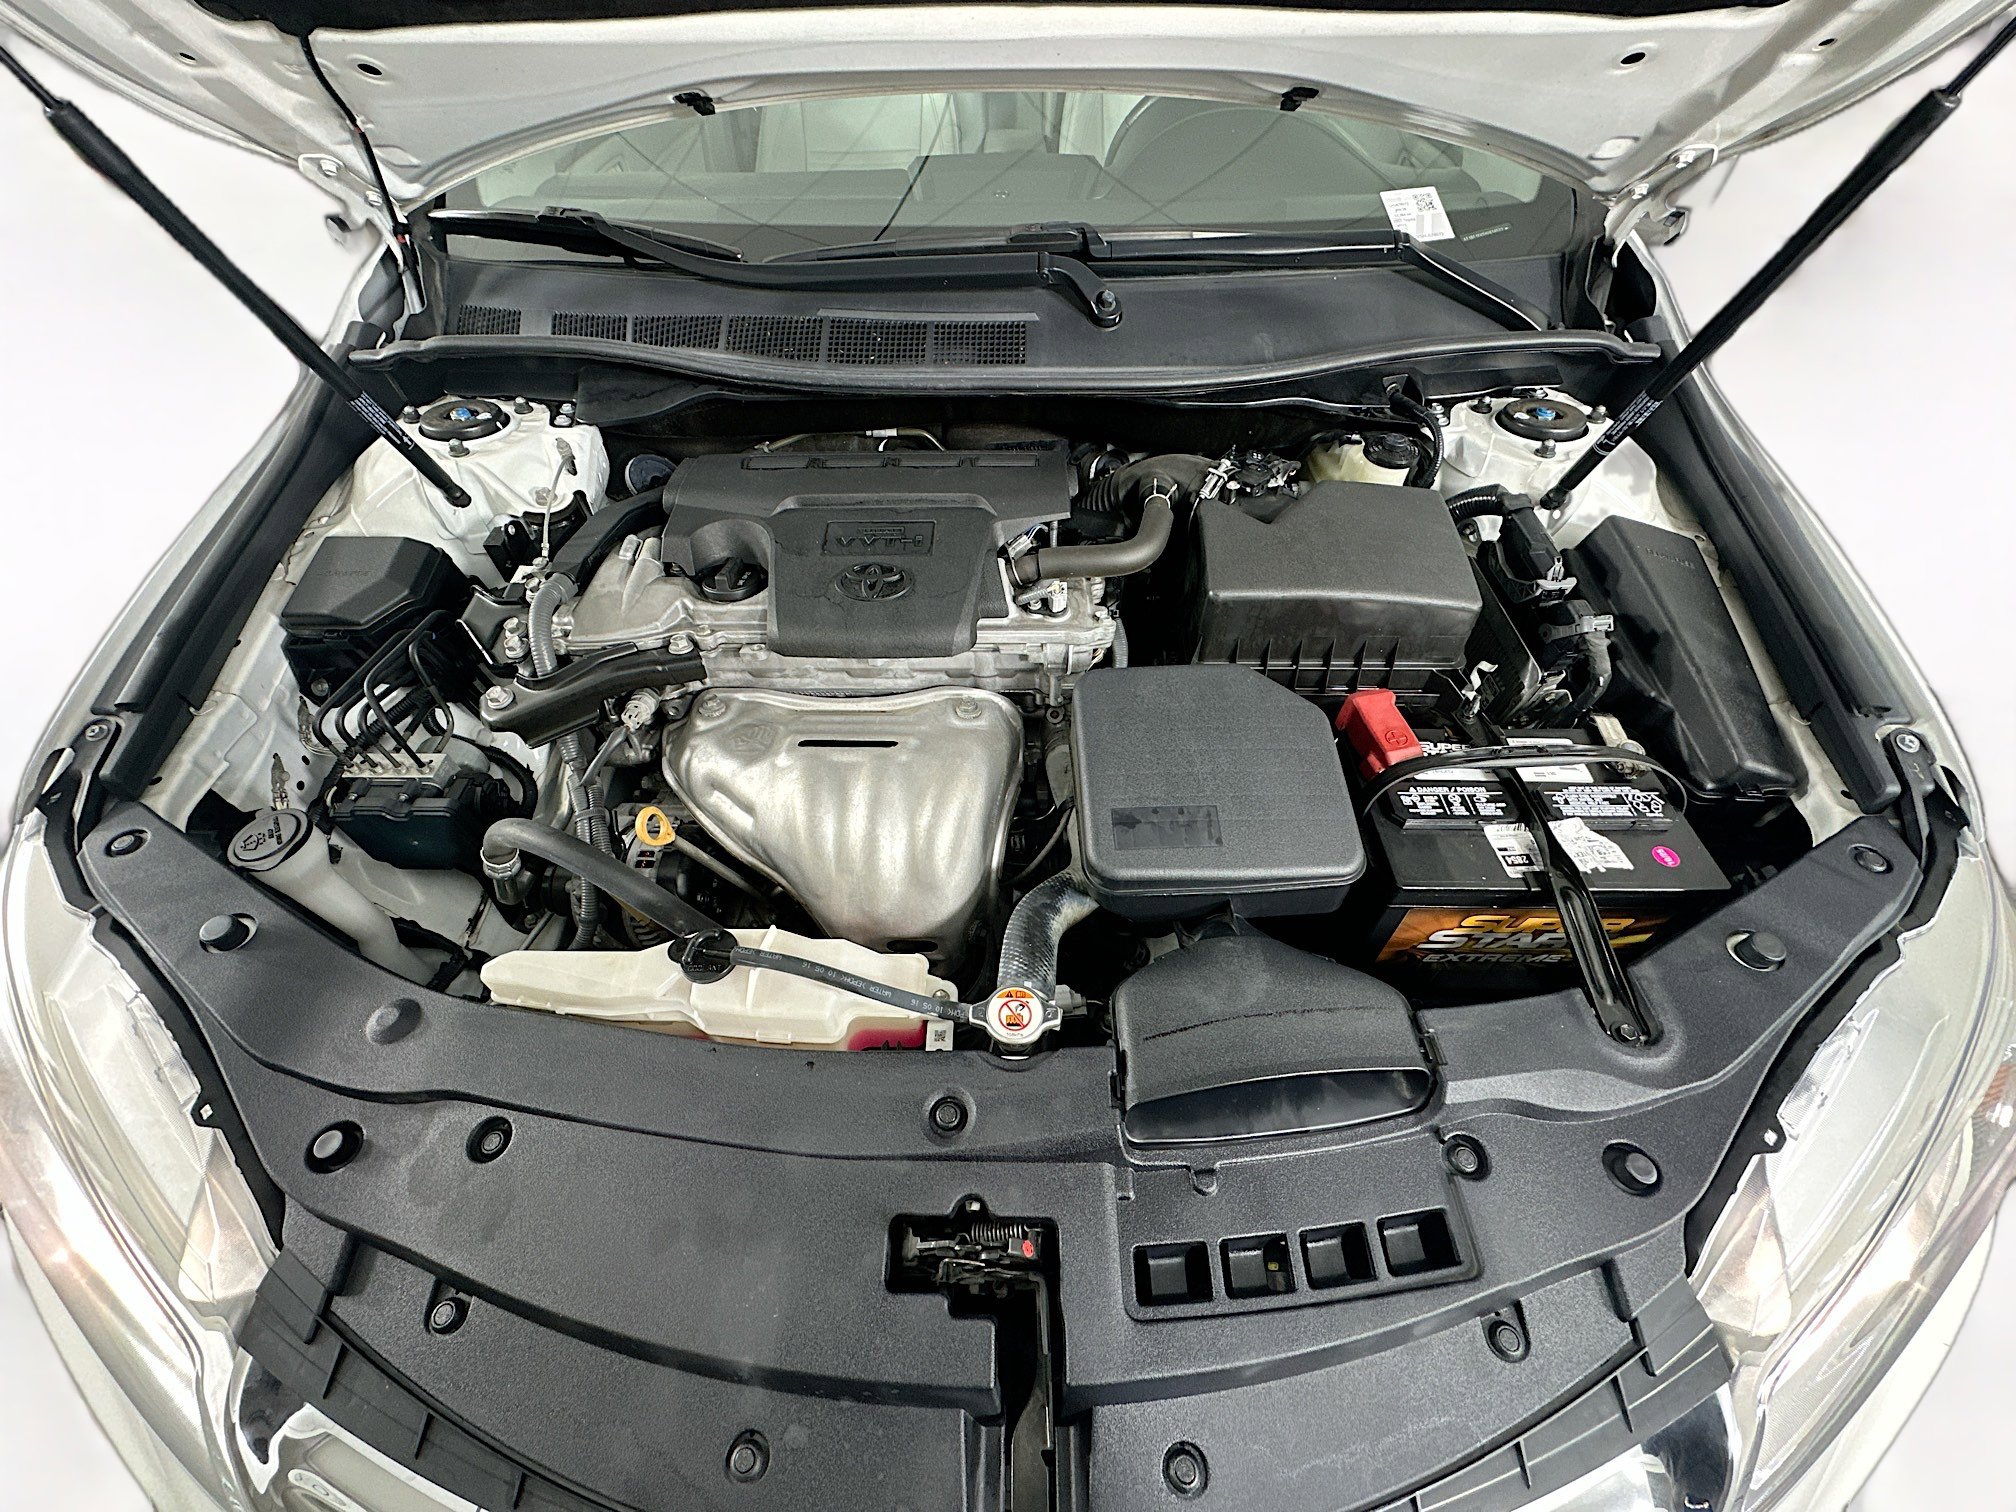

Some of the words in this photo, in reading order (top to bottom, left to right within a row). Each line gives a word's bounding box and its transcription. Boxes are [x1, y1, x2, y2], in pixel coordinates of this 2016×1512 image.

[1504, 855, 1529, 865] 2854
[1453, 914, 1635, 933] SUPR
[1416, 929, 1572, 949] STAR
[1422, 953, 1567, 963] EXTREME
[869, 984, 892, 998] WATER
